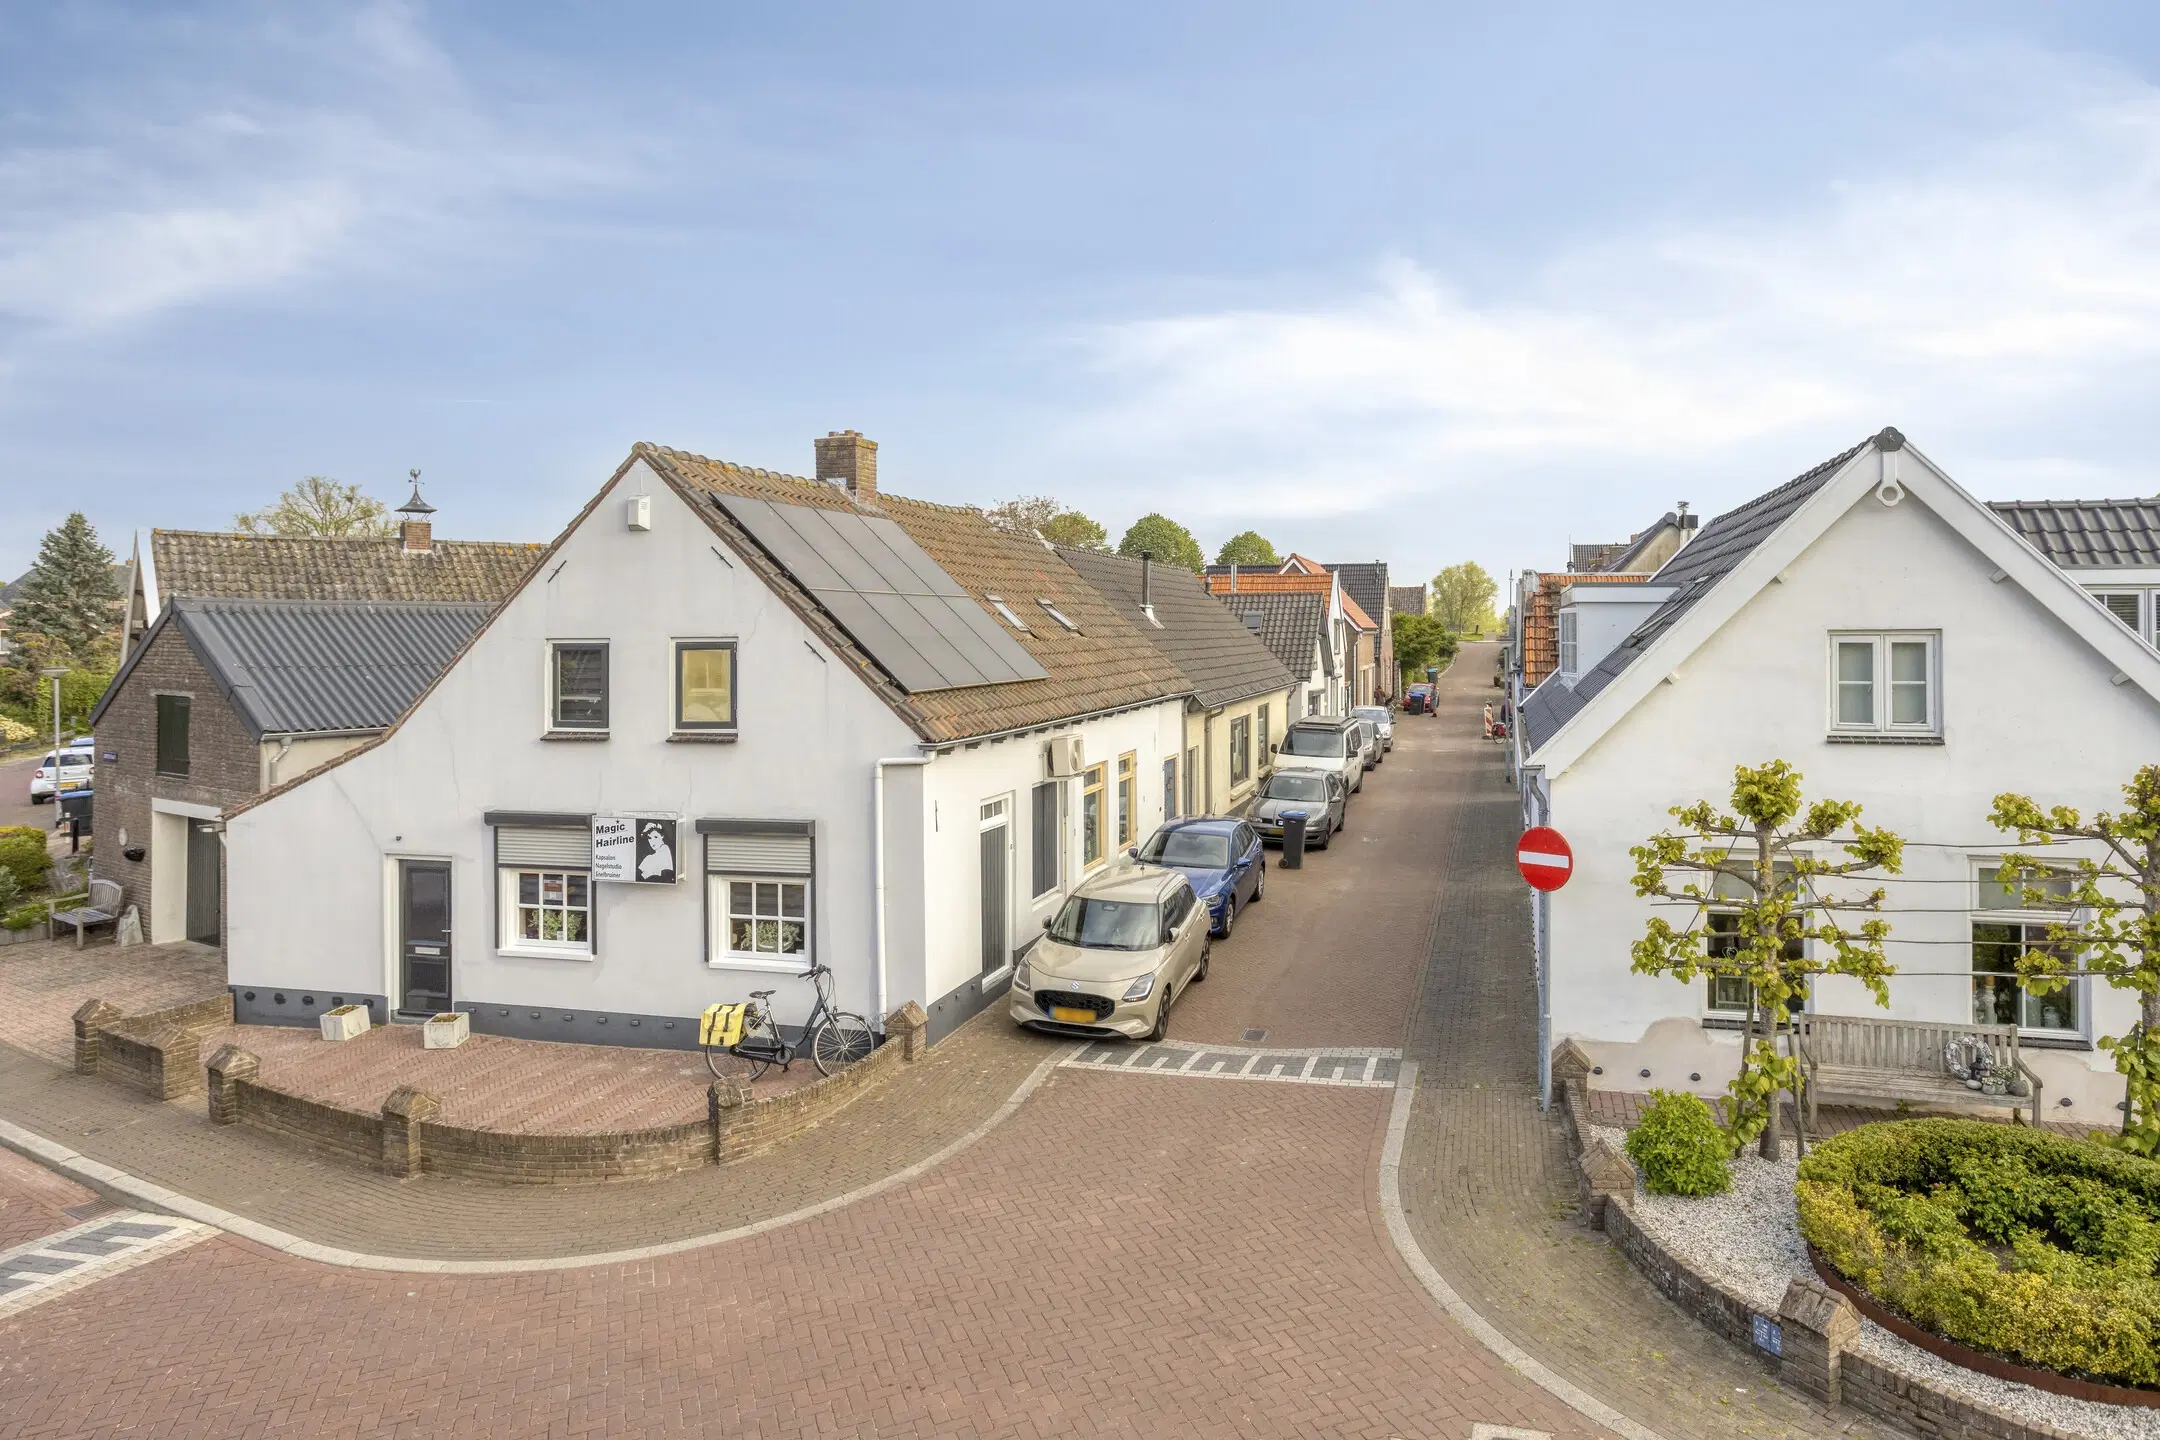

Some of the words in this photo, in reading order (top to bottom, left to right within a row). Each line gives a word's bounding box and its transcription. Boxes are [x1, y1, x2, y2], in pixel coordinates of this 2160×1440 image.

[595, 823, 626, 835] Magic
[595, 835, 635, 848] Hairline
[595, 862, 622, 870] Nagelstudio
